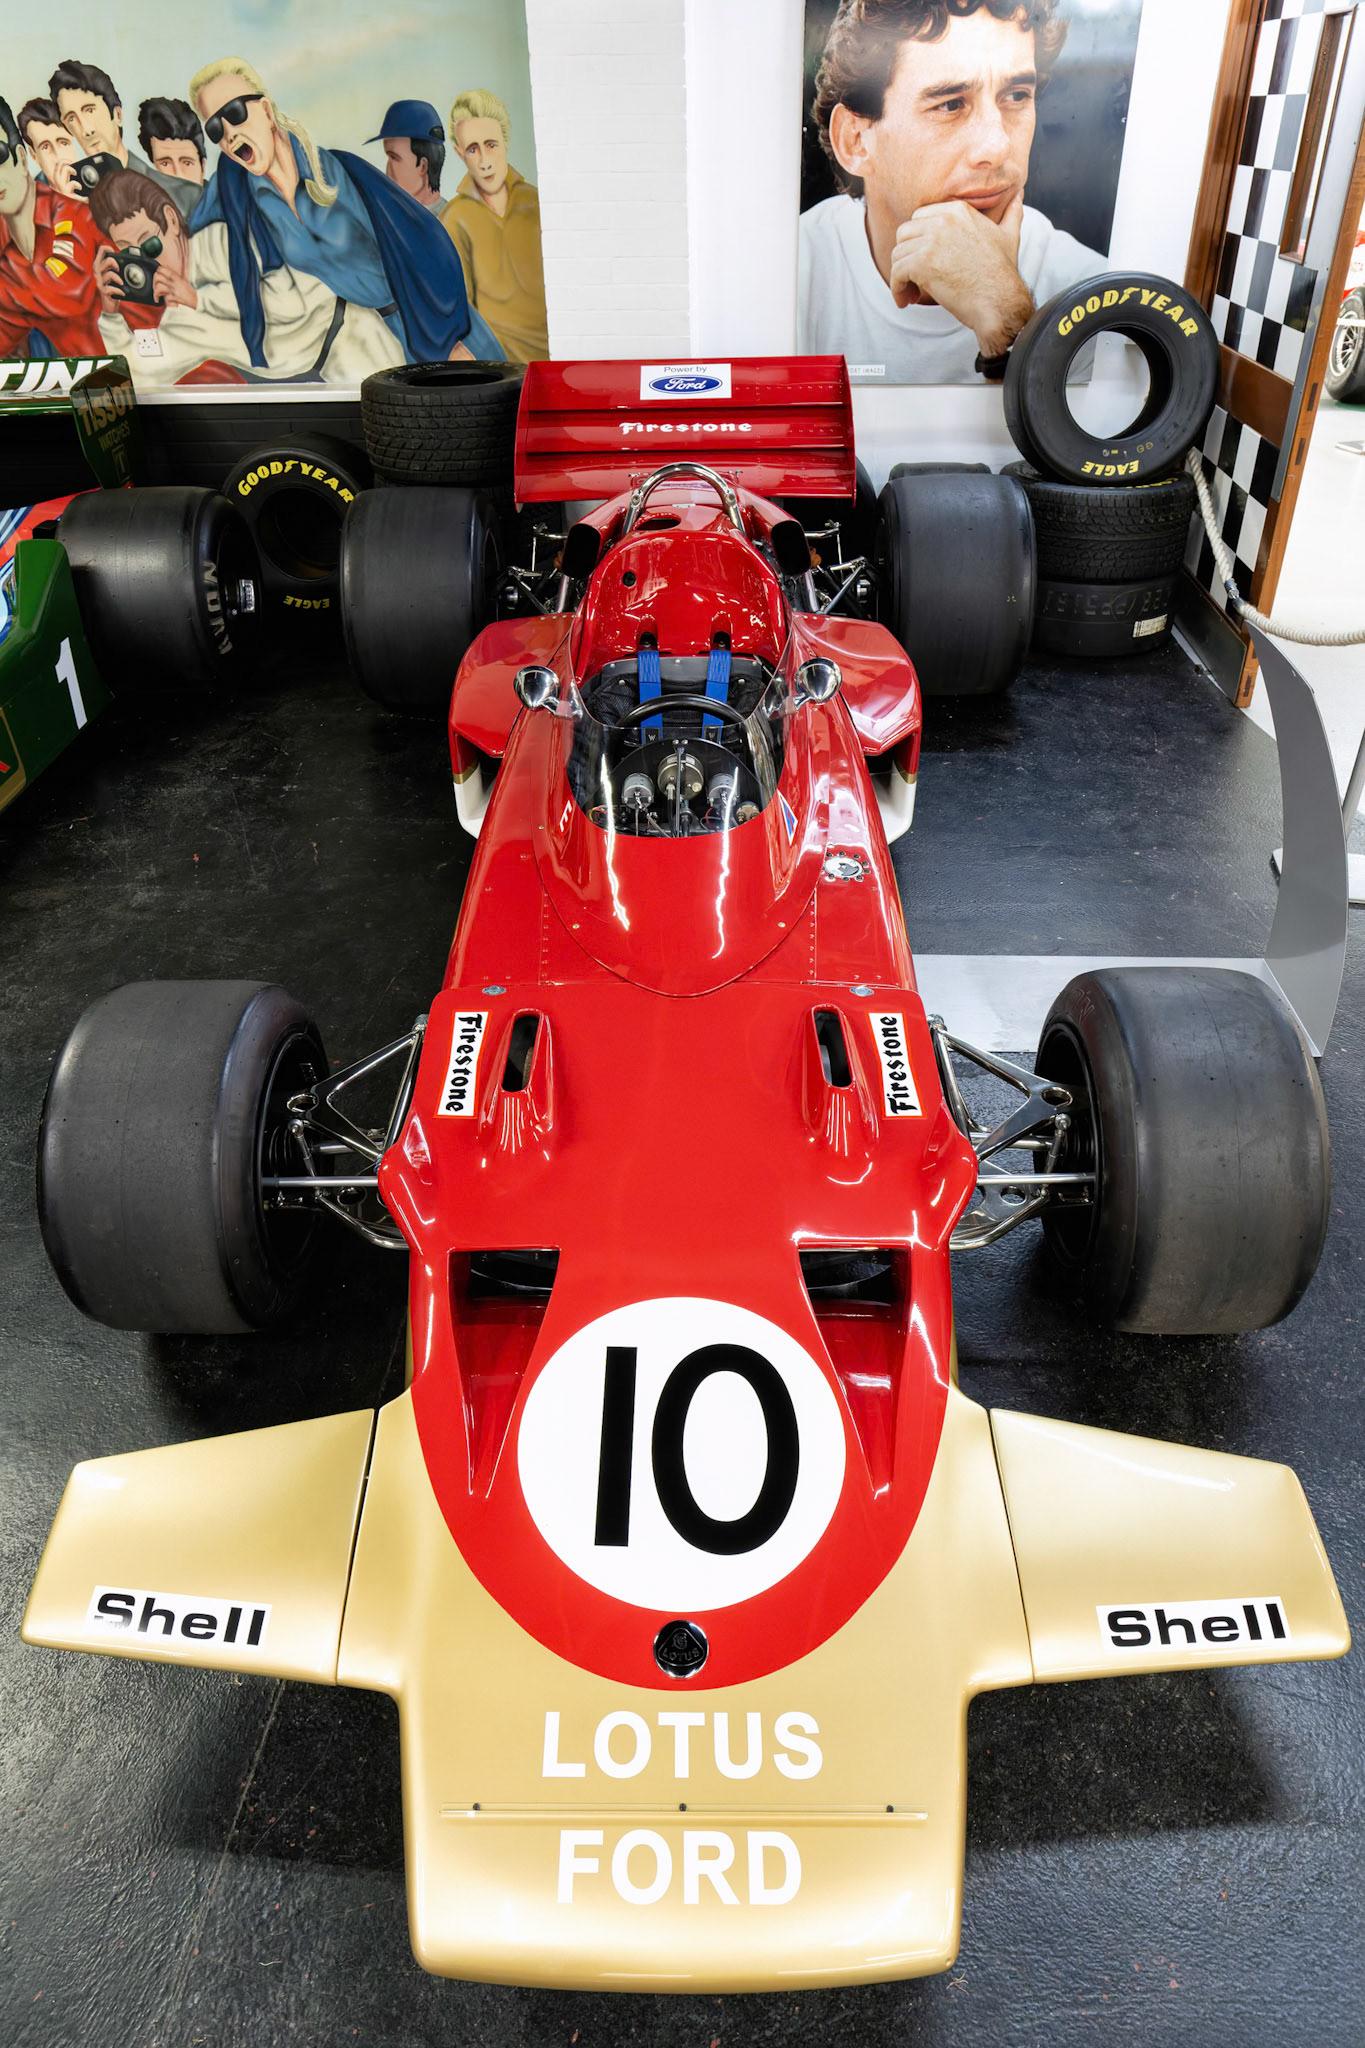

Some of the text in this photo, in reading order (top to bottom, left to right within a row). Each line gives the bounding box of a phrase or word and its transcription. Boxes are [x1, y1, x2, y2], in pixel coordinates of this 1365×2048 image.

[0, 360, 114, 393] TIN
[664, 378, 707, 390] Ford
[77, 380, 133, 437] TISSOT
[619, 422, 752, 435] Firestone
[1081, 460, 1139, 477] EAGLE
[283, 595, 330, 609] EAGLE
[55, 637, 88, 730] 1
[445, 1013, 483, 1113] Firestone
[880, 1016, 918, 1115] Firestone
[594, 1343, 800, 1556] 10
[94, 1593, 266, 1646] Shell
[1107, 1603, 1287, 1647] Shell
[662, 1648, 699, 1661] LOTUS
[541, 1710, 824, 1780] LOTUS
[557, 1829, 802, 1906] FORD
